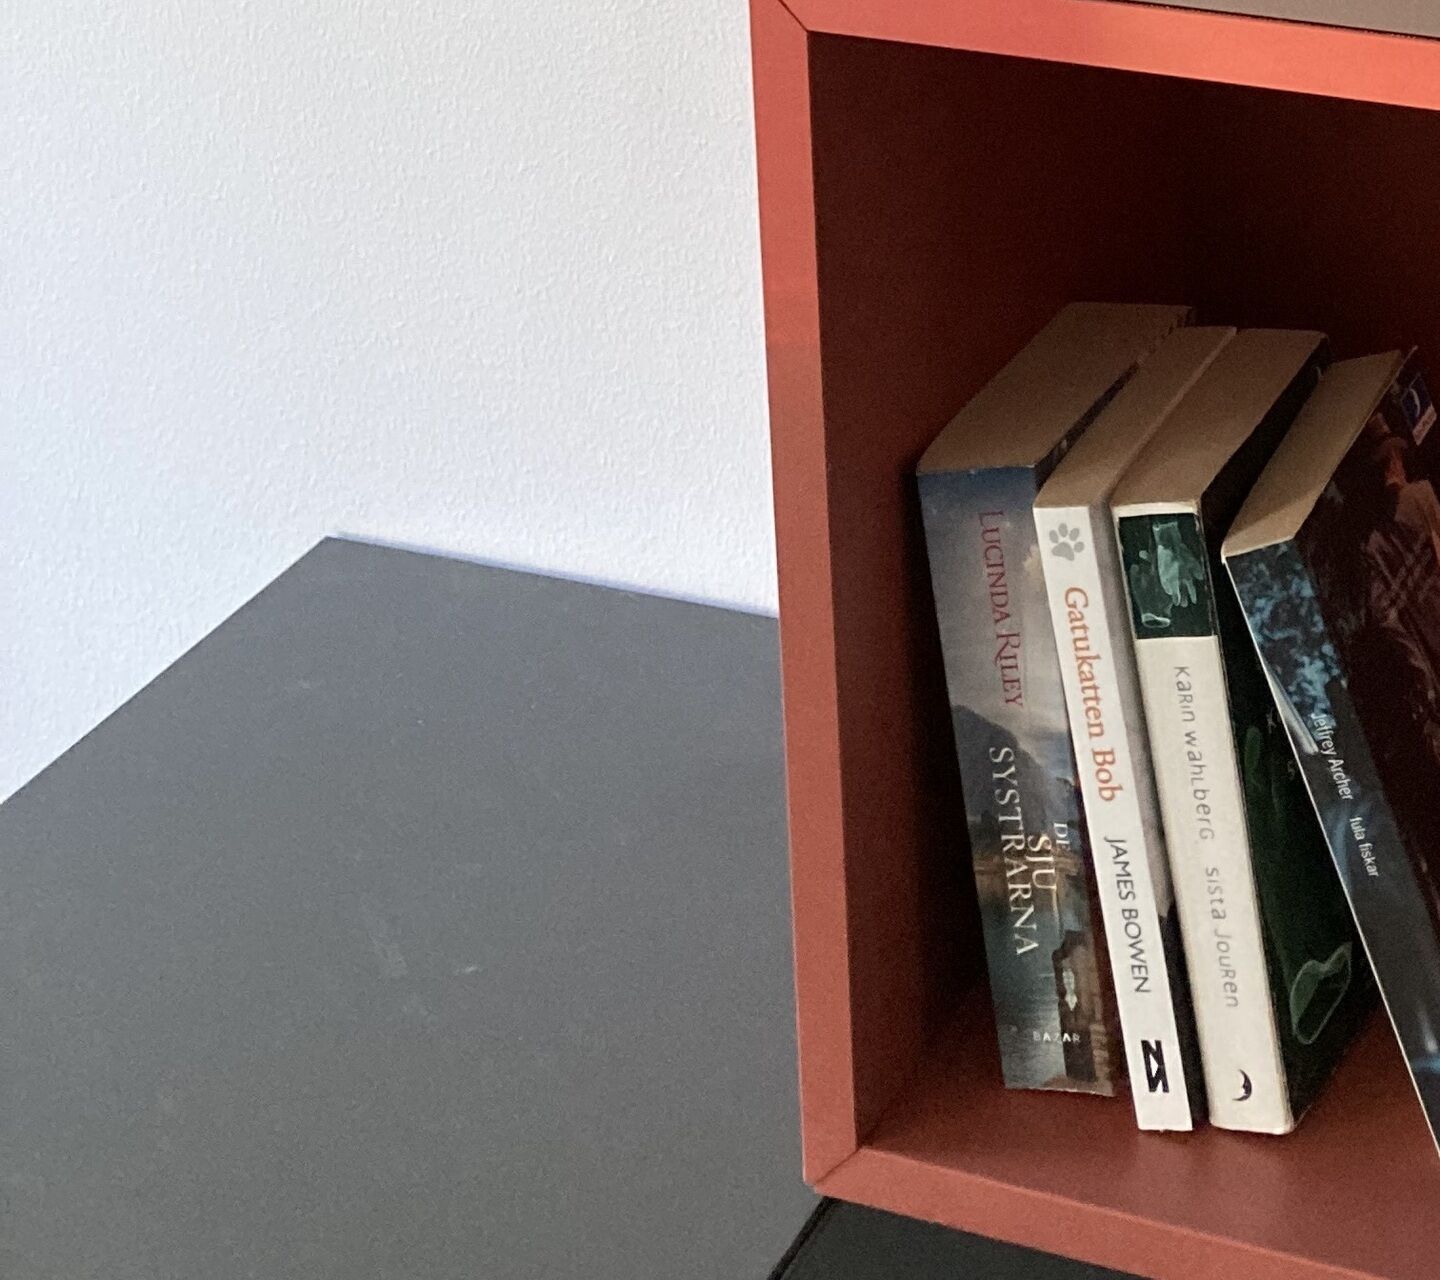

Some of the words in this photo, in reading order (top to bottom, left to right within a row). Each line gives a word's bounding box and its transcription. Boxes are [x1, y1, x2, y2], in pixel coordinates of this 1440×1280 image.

[977, 511, 1012, 625] LUCINDA
[995, 631, 1023, 708] RILEY
[1064, 587, 1106, 740] Gatukatten
[1092, 747, 1124, 802] Bob
[1311, 713, 1338, 756] Jeffrey
[1328, 758, 1354, 800] Archer
[989, 746, 1040, 956] SYSTRARNA
[1027, 834, 1058, 891] SJU
[1104, 837, 1136, 902] JAMES
[1122, 908, 1152, 994] BOWEN
[1350, 816, 1365, 841] fula
[1359, 843, 1379, 878] fiskar
